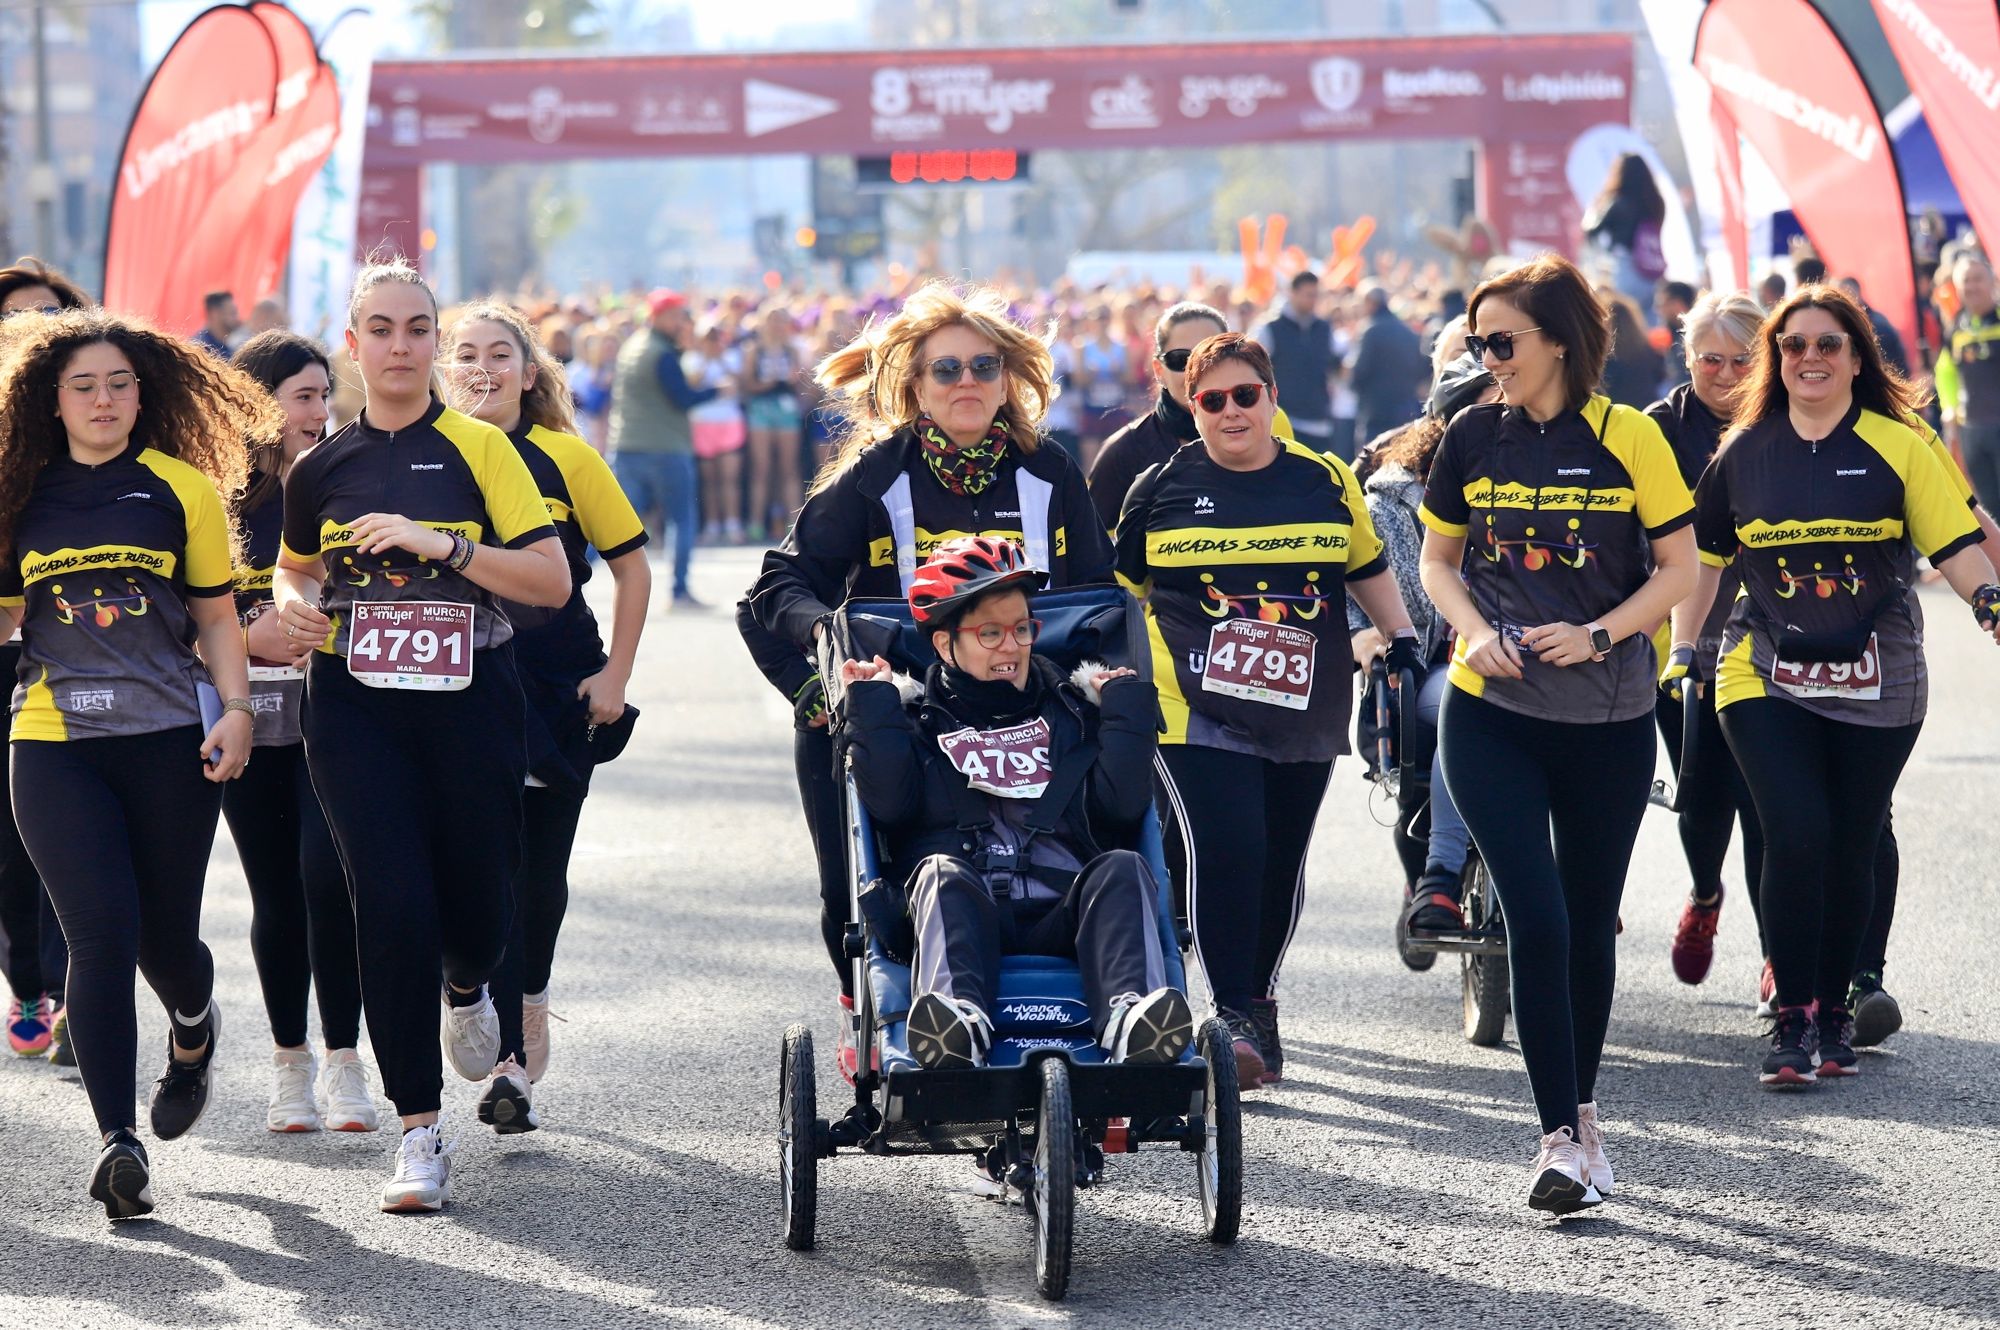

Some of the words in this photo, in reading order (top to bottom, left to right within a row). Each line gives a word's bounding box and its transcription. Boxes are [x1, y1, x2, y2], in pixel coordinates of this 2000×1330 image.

[1750, 528, 1801, 543] ZANCADAS
[1801, 527, 1842, 539] SOBRE
[1843, 526, 1883, 539] RUEDAS
[1158, 537, 1239, 556] ZANCADAS
[1239, 536, 1308, 552] SOBRE
[78, 551, 122, 565] SOBRE
[124, 551, 164, 568] RUEDAS
[377, 609, 414, 626] mujer
[423, 606, 466, 618] MURCIA
[1235, 627, 1269, 643] mujer
[1277, 630, 1311, 643] MURCIA
[353, 628, 462, 665] 4791
[396, 665, 422, 673] MARIA
[1212, 642, 1309, 685] 4793
[1249, 679, 1267, 687] PEPA
[999, 726, 1043, 743] MURCIA
[1010, 778, 1031, 786] LIDIA
[1002, 1003, 1062, 1013] Advance
[1015, 1011, 1071, 1023] Mobility
